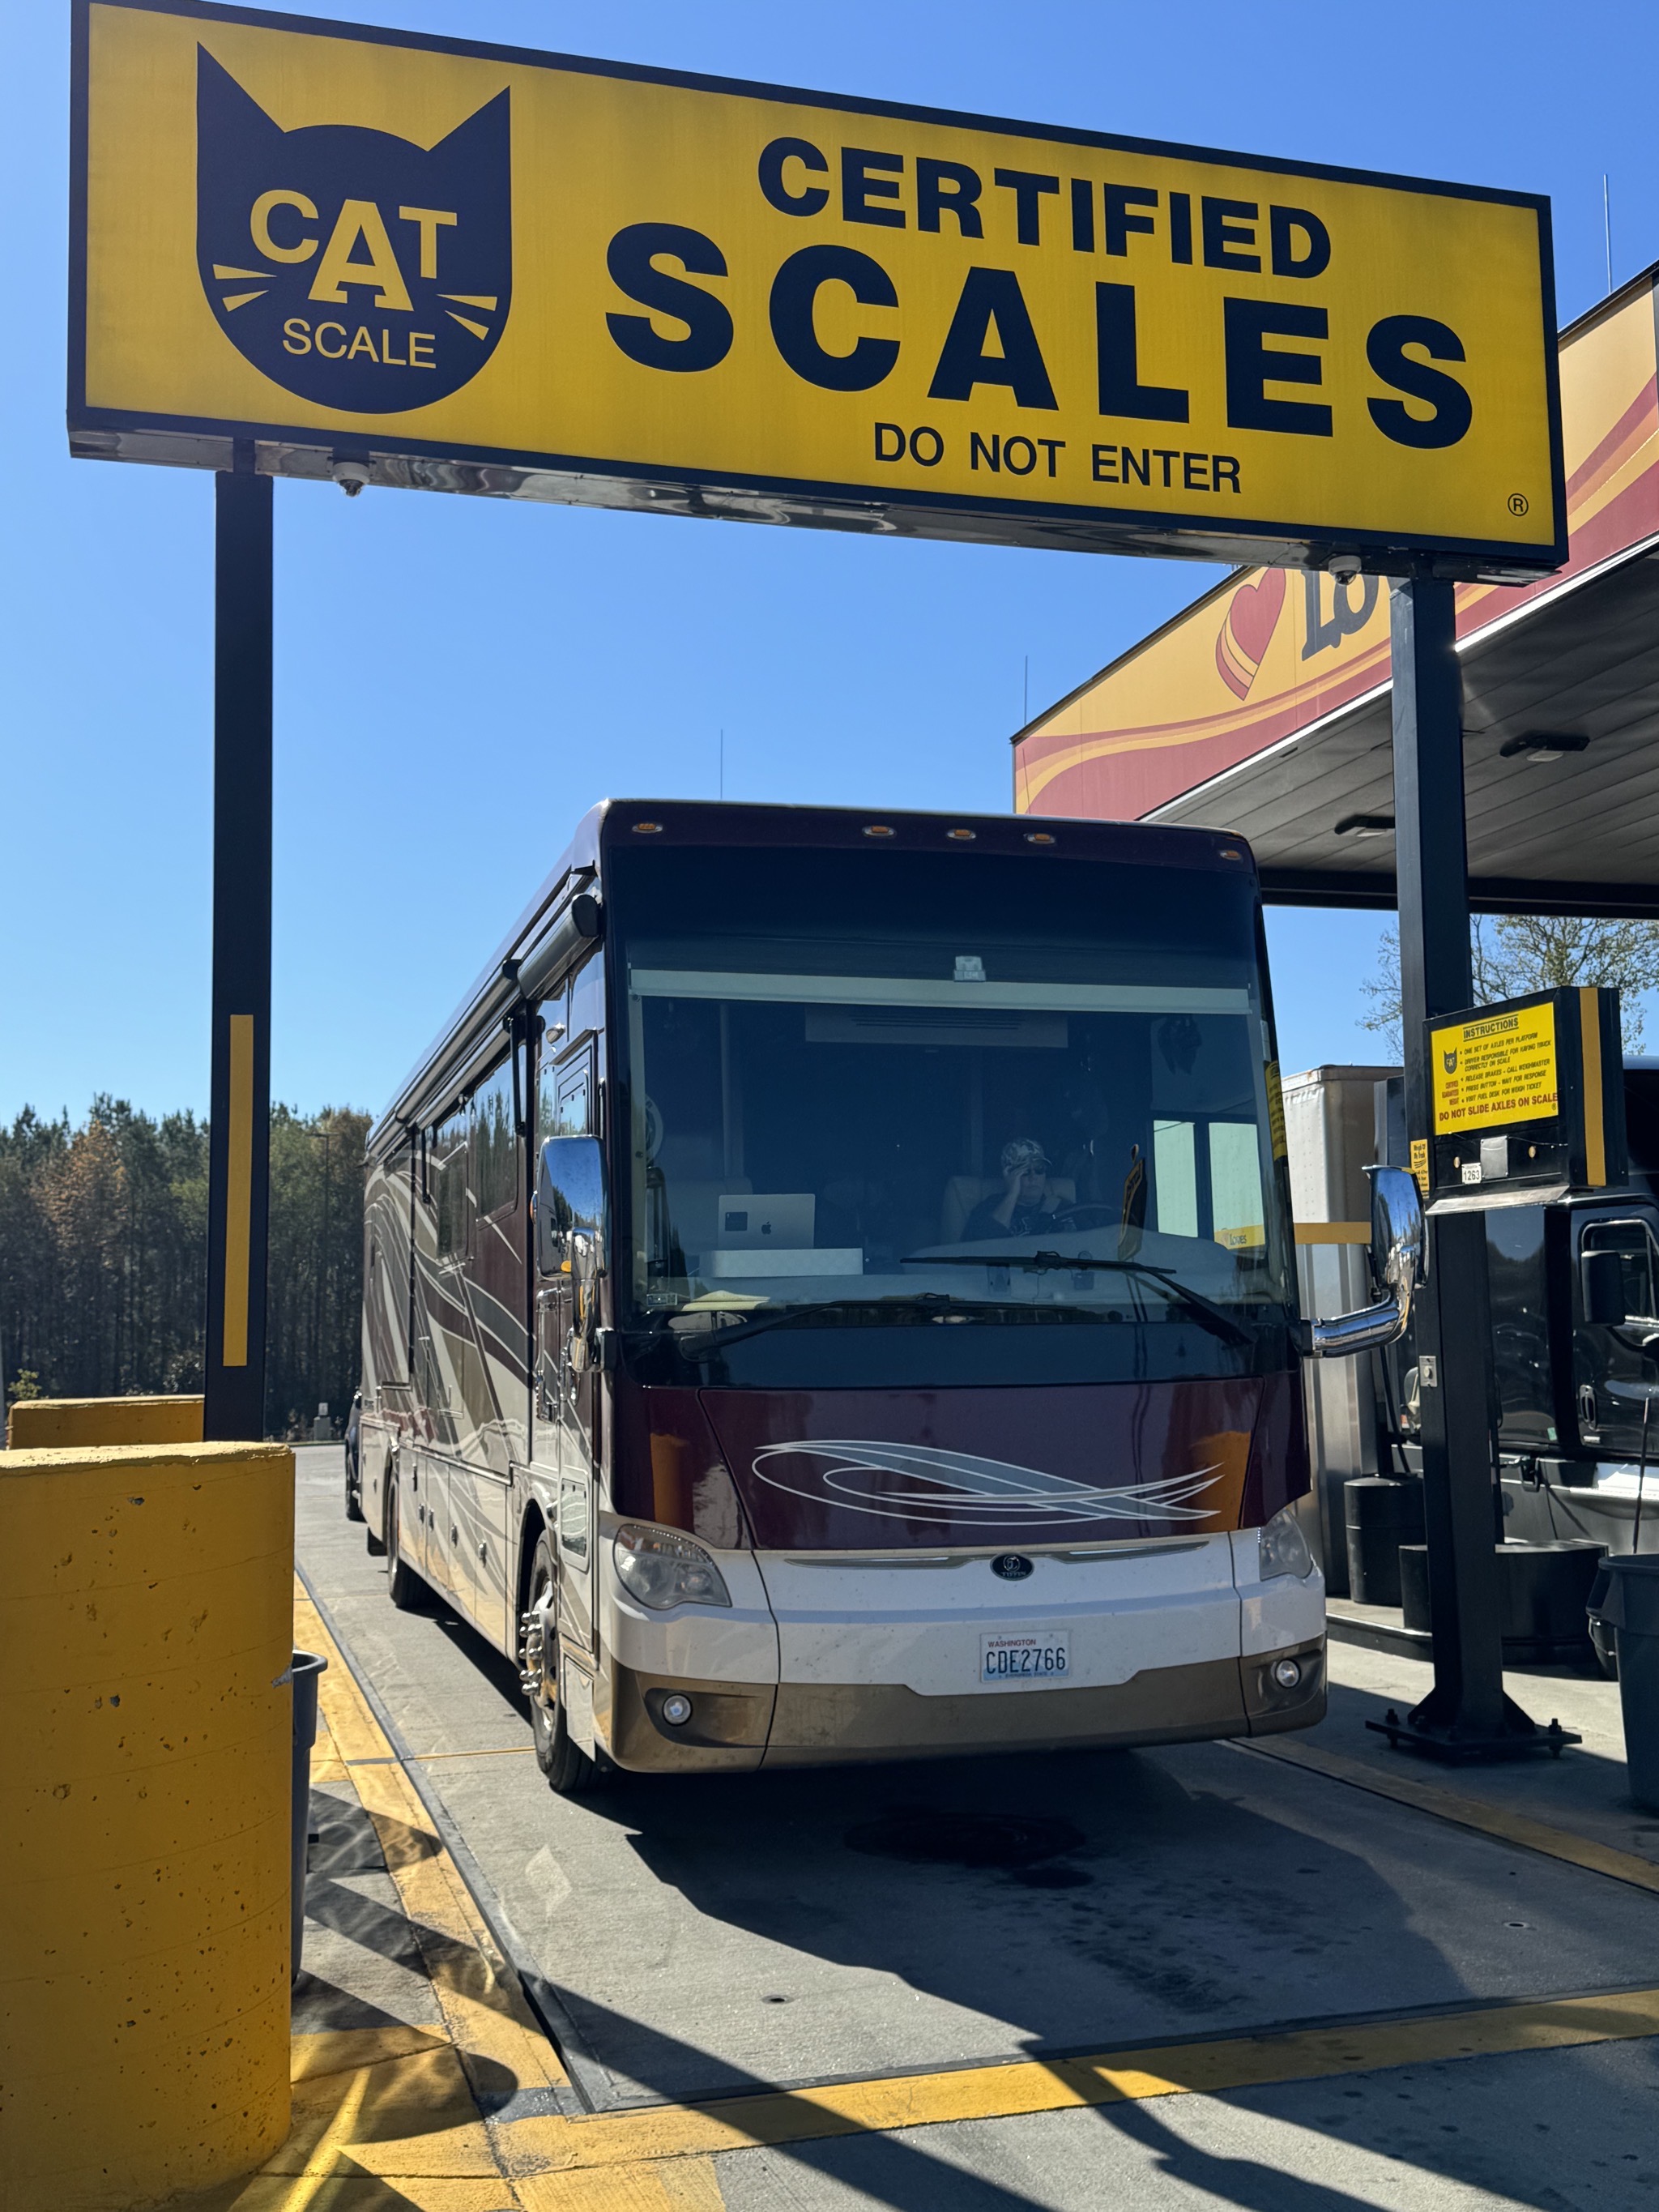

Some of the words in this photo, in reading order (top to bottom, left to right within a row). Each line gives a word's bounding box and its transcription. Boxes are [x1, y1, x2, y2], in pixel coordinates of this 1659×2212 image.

[758, 137, 1331, 279] CERTIFIED
[250, 190, 457, 311] CAT
[282, 318, 437, 369] SCALE
[605, 222, 1473, 449] SCALES
[875, 422, 944, 467] DO
[970, 432, 1066, 477] NOT
[1092, 444, 1241, 493] ENTER
[1464, 1018, 1518, 1039] INSTRUCTIONS
[1516, 1032, 1537, 1043] PLATFORM
[1439, 1112, 1449, 1121] DO
[1452, 1108, 1466, 1119] NOT
[1468, 1104, 1490, 1116] SLIDE
[1491, 1099, 1516, 1112] AXLES
[1518, 1097, 1529, 1107] ON
[1532, 1092, 1558, 1105] SCALE
[1464, 1170, 1480, 1181] 1263
[988, 1638, 1036, 1648] WASHINGTON
[986, 1647, 1066, 1675] CDE2766
